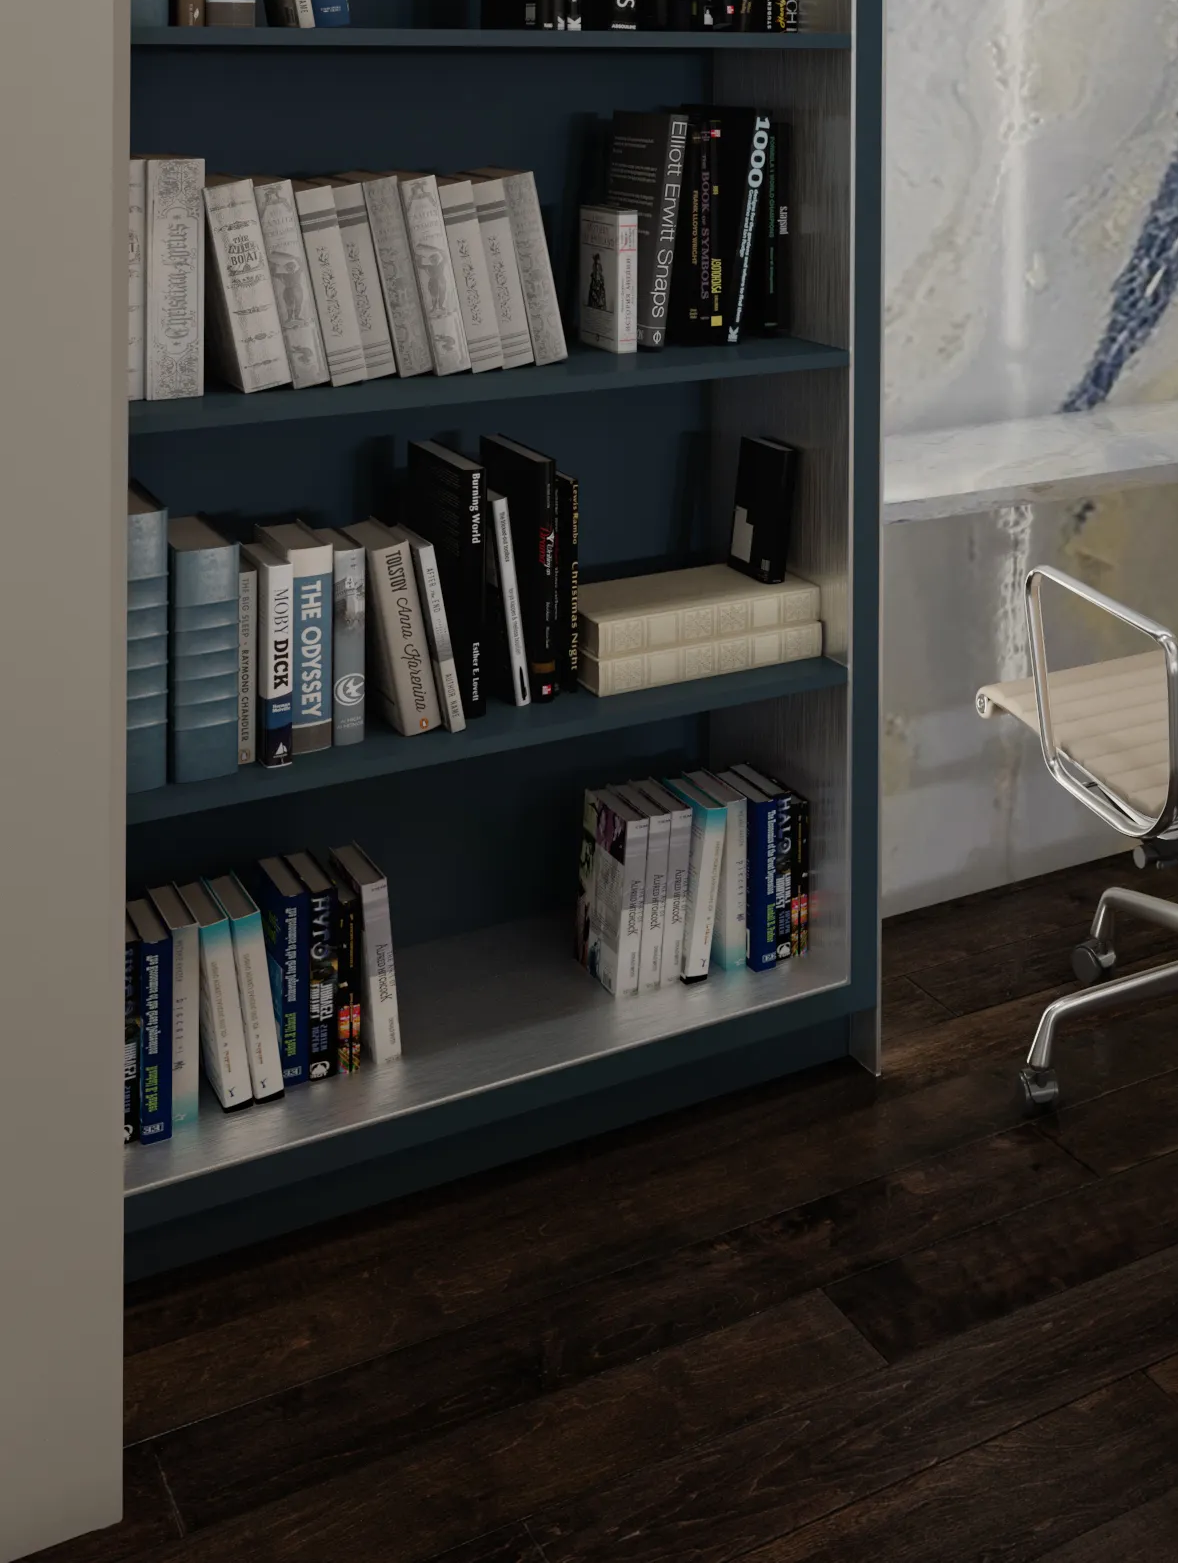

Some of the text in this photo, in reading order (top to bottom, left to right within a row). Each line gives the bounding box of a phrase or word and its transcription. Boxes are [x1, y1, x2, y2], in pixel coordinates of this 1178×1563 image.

[748, 116, 770, 188] 1000
[701, 170, 710, 212] BOOK
[233, 236, 249, 244] THE
[649, 120, 688, 319] Elliott Erwitt Snaps
[779, 205, 789, 235] posters
[231, 252, 257, 266] BOAT
[700, 226, 710, 300] SYMBOLS
[711, 258, 722, 294] PSYCHOLOGY
[470, 472, 481, 544] Burning World
[426, 568, 436, 586] AFTER
[432, 599, 441, 613] END
[569, 560, 578, 628] Christmas
[273, 589, 290, 689] MOBY DICK
[300, 580, 323, 717] THE ODYSSEY
[385, 550, 427, 713] TOLSTOY Anna Karenina
[472, 641, 480, 666] Esther
[568, 631, 577, 671] Night
[241, 578, 250, 742] THE BIG SLEEP RAYMOND CHANDLER
[445, 673, 459, 718] AUTHOR NAME
[472, 677, 480, 702] Lovett
[778, 797, 792, 854] HALO
[767, 856, 777, 869] Great
[767, 870, 777, 895] Depression
[627, 879, 641, 936] ALFRED HITCHCOCK
[649, 874, 664, 931] ALFRED HITCHCOCK
[775, 876, 785, 910] HARVEST
[377, 943, 392, 1002] ALFRED HITCHCOCK
